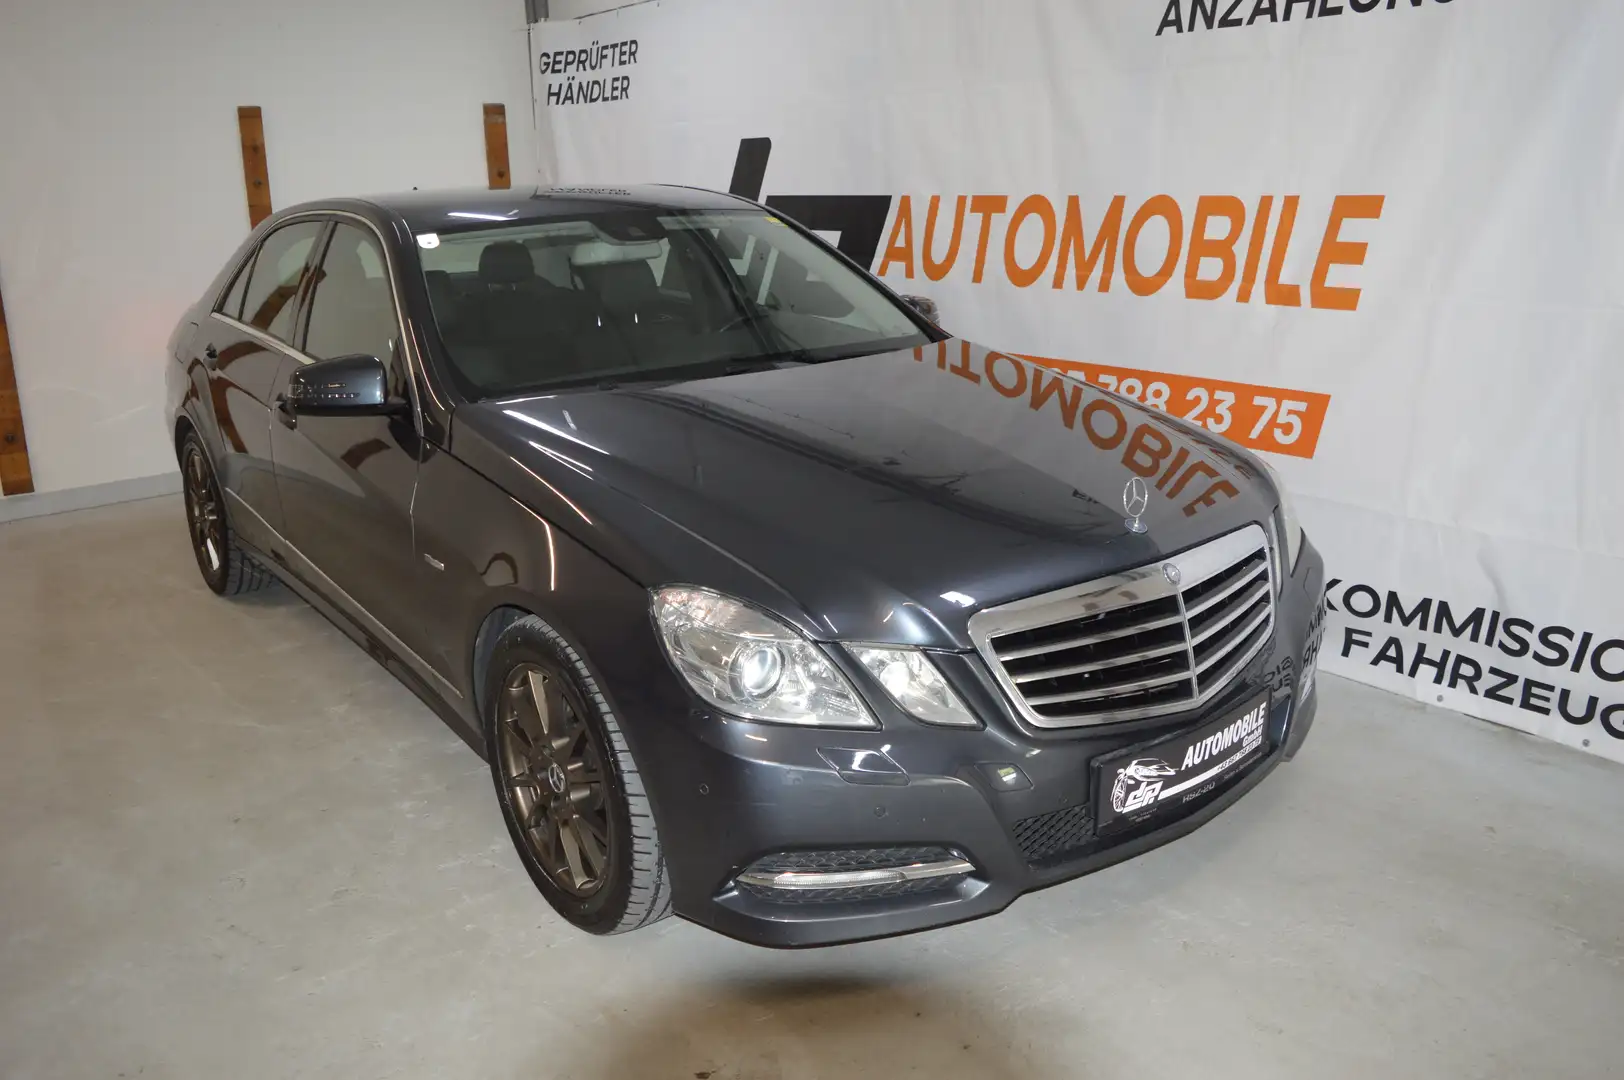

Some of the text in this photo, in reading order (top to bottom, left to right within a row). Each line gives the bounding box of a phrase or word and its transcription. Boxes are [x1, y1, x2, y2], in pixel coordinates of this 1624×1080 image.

[540, 40, 638, 74] GEPRÜFTER
[547, 76, 630, 106] HÄNDLER
[877, 194, 1386, 311] AUTOMOBILE
[1183, 387, 1236, 433] 23
[1248, 398, 1308, 445] 75
[1181, 702, 1267, 770] AUTOMOBILE
